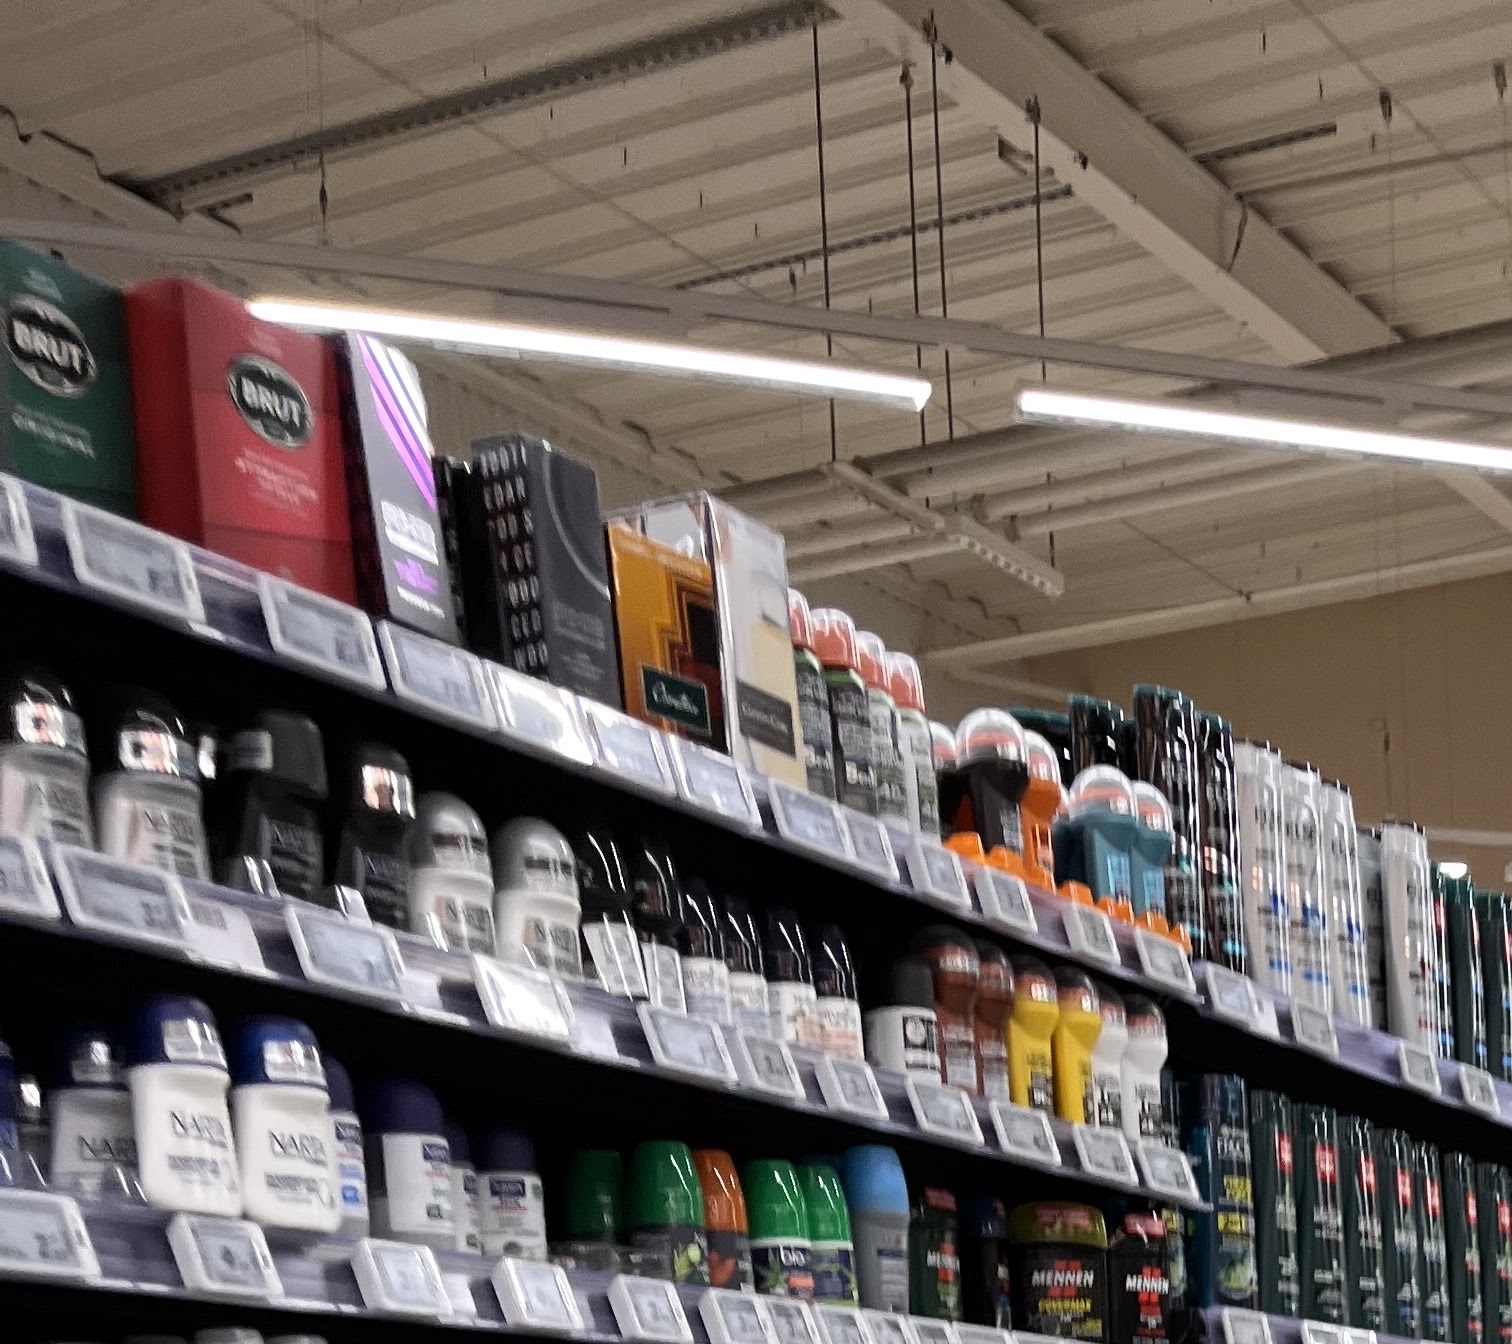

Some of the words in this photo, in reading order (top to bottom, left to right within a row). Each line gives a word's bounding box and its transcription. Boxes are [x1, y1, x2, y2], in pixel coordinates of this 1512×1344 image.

[12, 317, 83, 376] BRUT
[240, 376, 302, 429] BRUT
[1031, 1268, 1094, 1288] MENNEN
[1125, 1273, 1170, 1295] MENNEN
